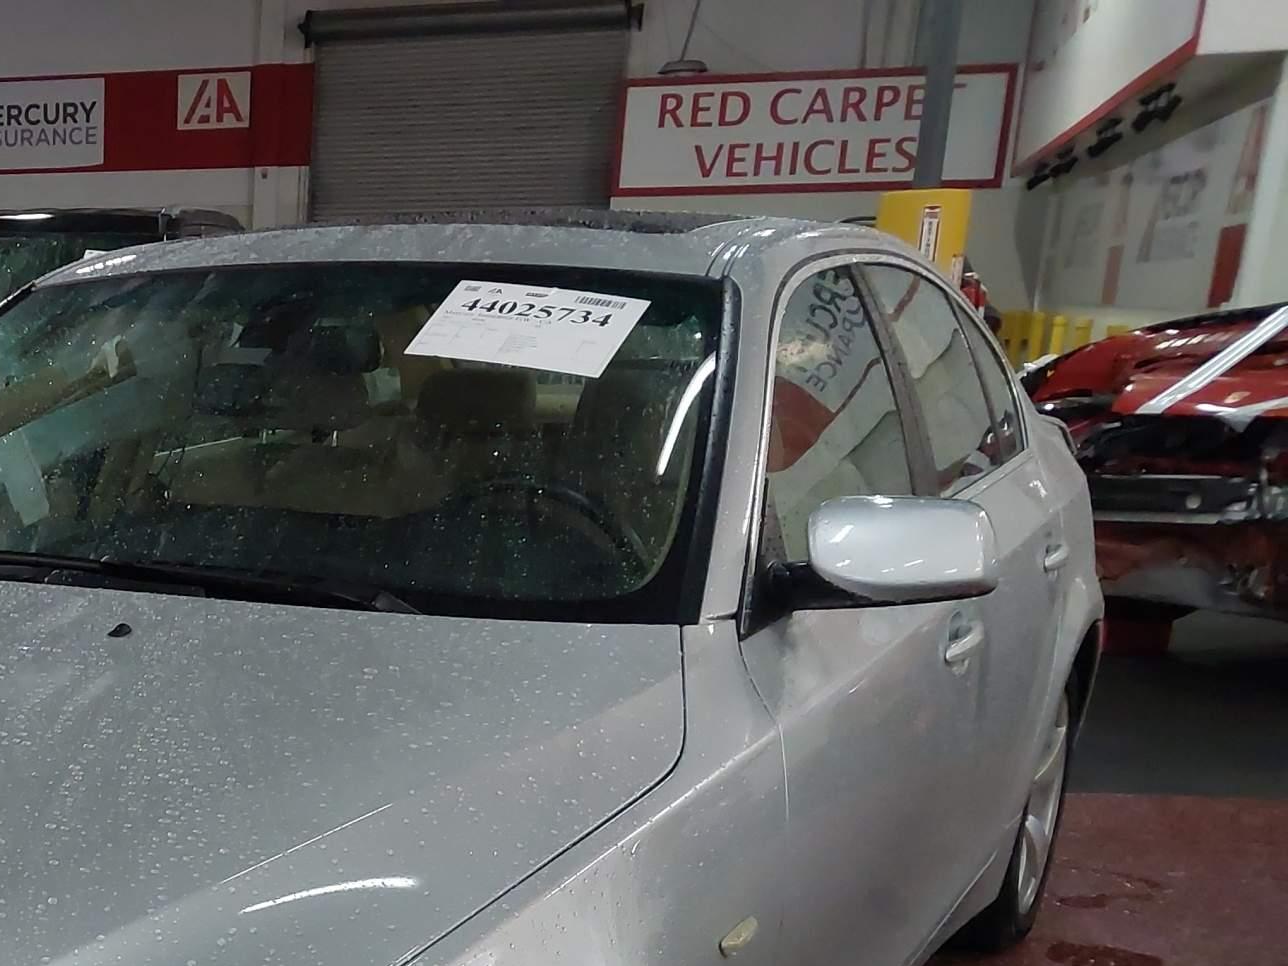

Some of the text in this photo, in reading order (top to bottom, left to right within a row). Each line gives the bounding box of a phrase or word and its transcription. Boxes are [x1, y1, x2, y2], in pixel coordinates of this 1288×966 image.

[657, 83, 967, 129] RED CARPE
[694, 136, 919, 178] VEHICLES
[461, 298, 613, 328] 44025734
